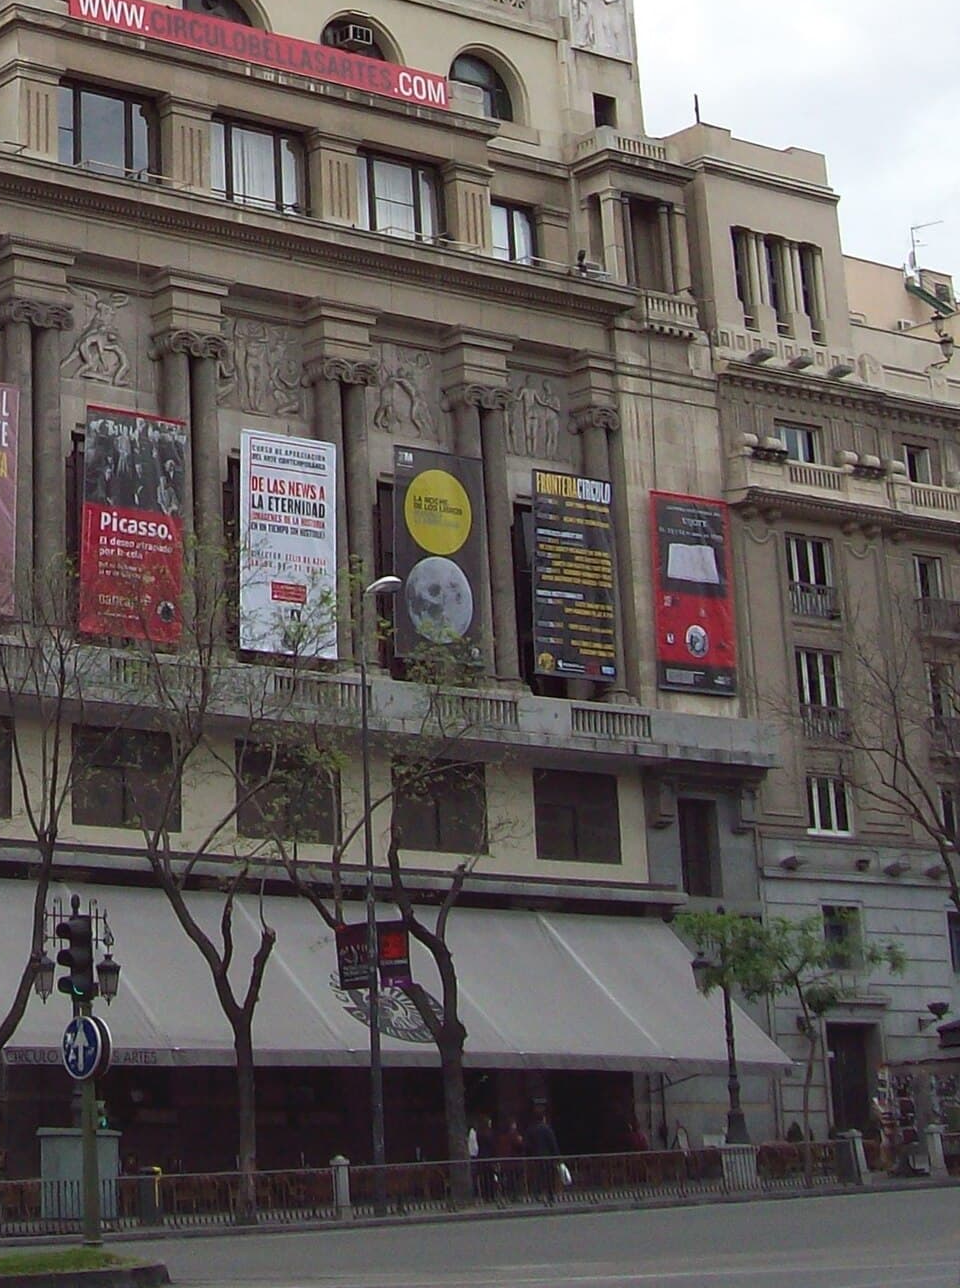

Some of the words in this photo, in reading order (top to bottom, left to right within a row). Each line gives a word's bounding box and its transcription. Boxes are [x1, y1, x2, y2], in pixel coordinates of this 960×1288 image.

[252, 476, 264, 492] DE
[267, 478, 286, 495] LAS
[288, 481, 317, 500] NEWS
[319, 486, 326, 502] A
[252, 494, 264, 510] LA
[268, 496, 326, 519] ETERNIDAD
[100, 511, 173, 541] Picasso.
